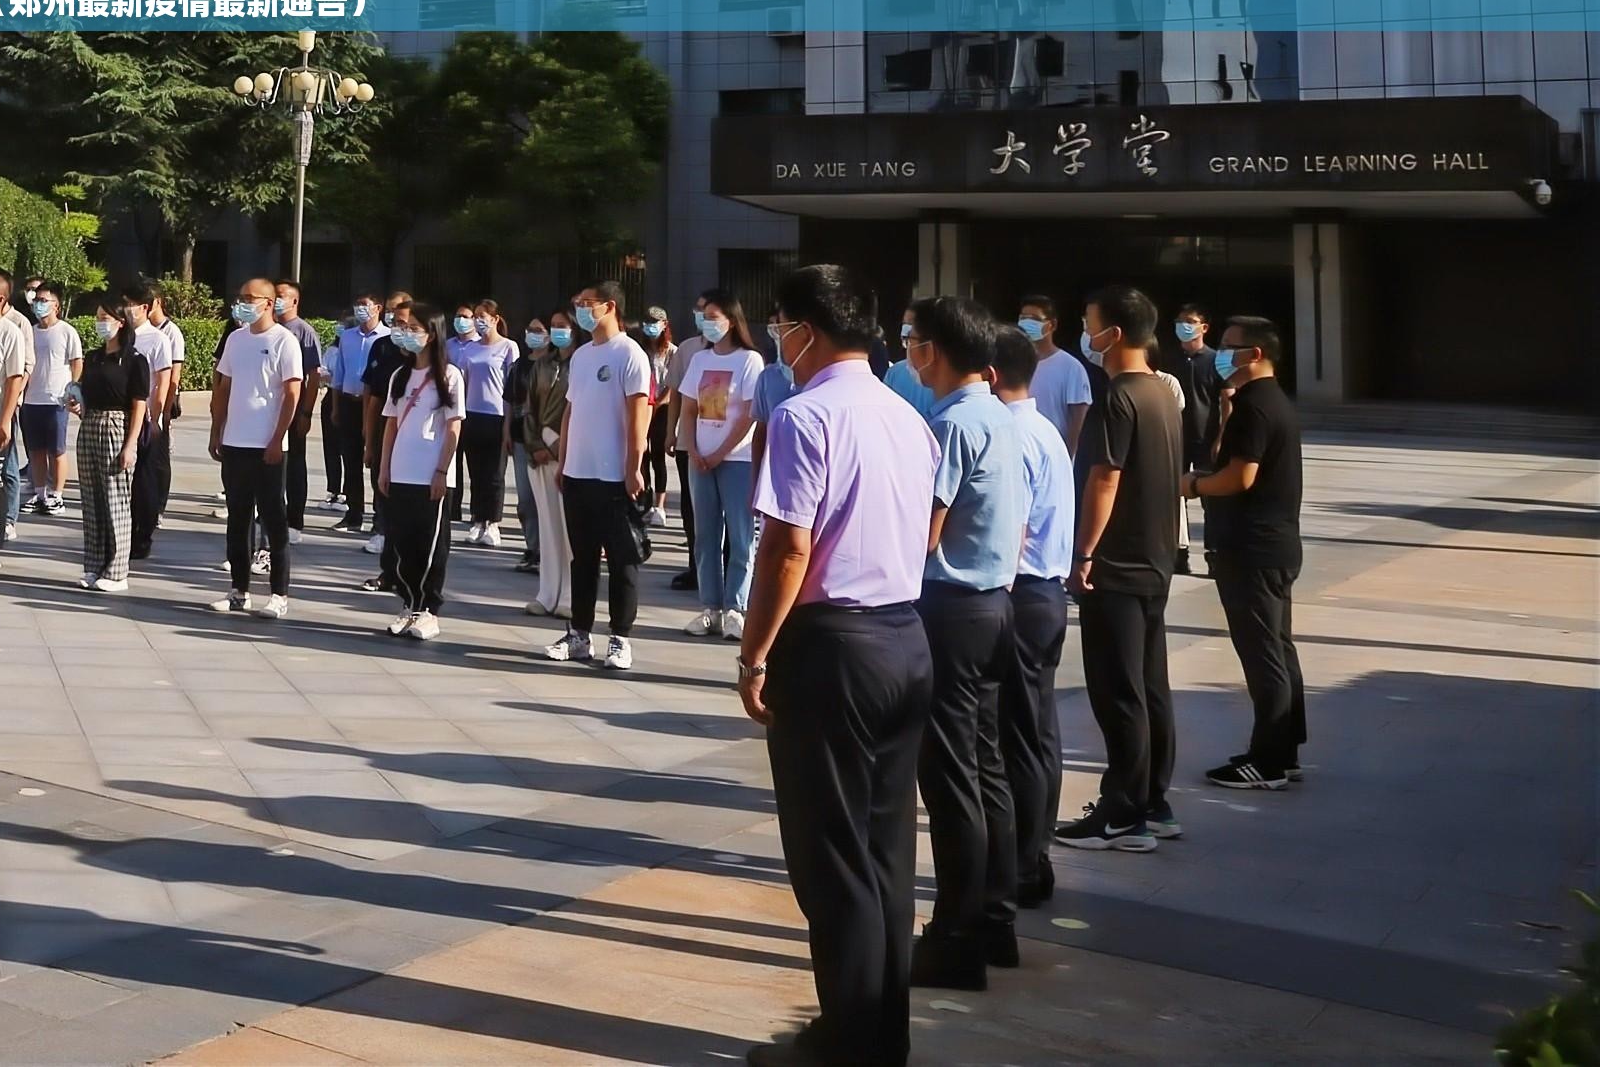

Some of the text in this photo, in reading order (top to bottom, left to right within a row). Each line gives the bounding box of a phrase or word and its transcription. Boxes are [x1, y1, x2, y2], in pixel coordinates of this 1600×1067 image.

[990, 114, 1170, 175] 大学堂
[776, 161, 916, 179] DA XUE TANG
[1208, 151, 1489, 173] GRAND LEARNING HALL
